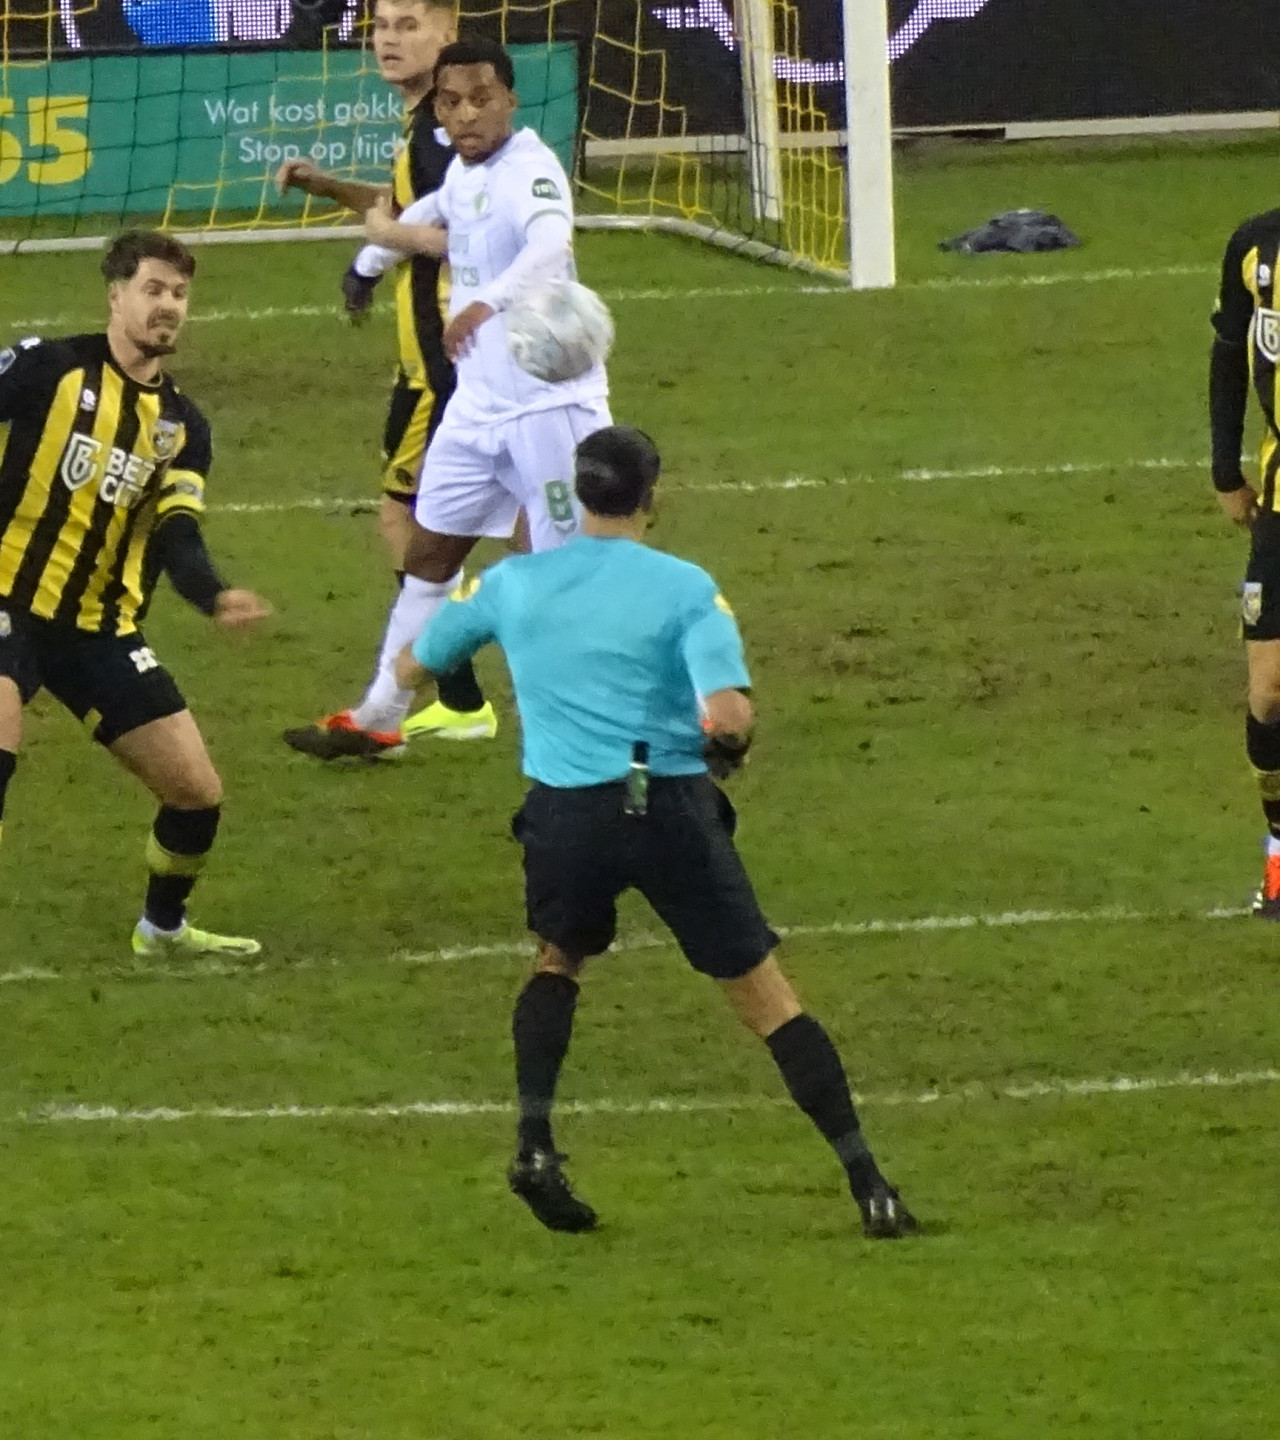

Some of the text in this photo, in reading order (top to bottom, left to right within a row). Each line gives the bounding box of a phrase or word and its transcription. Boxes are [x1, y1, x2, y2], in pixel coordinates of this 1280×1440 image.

[204, 92, 402, 127] Wat kost gokk
[239, 136, 301, 163] Stop
[310, 140, 347, 166] op
